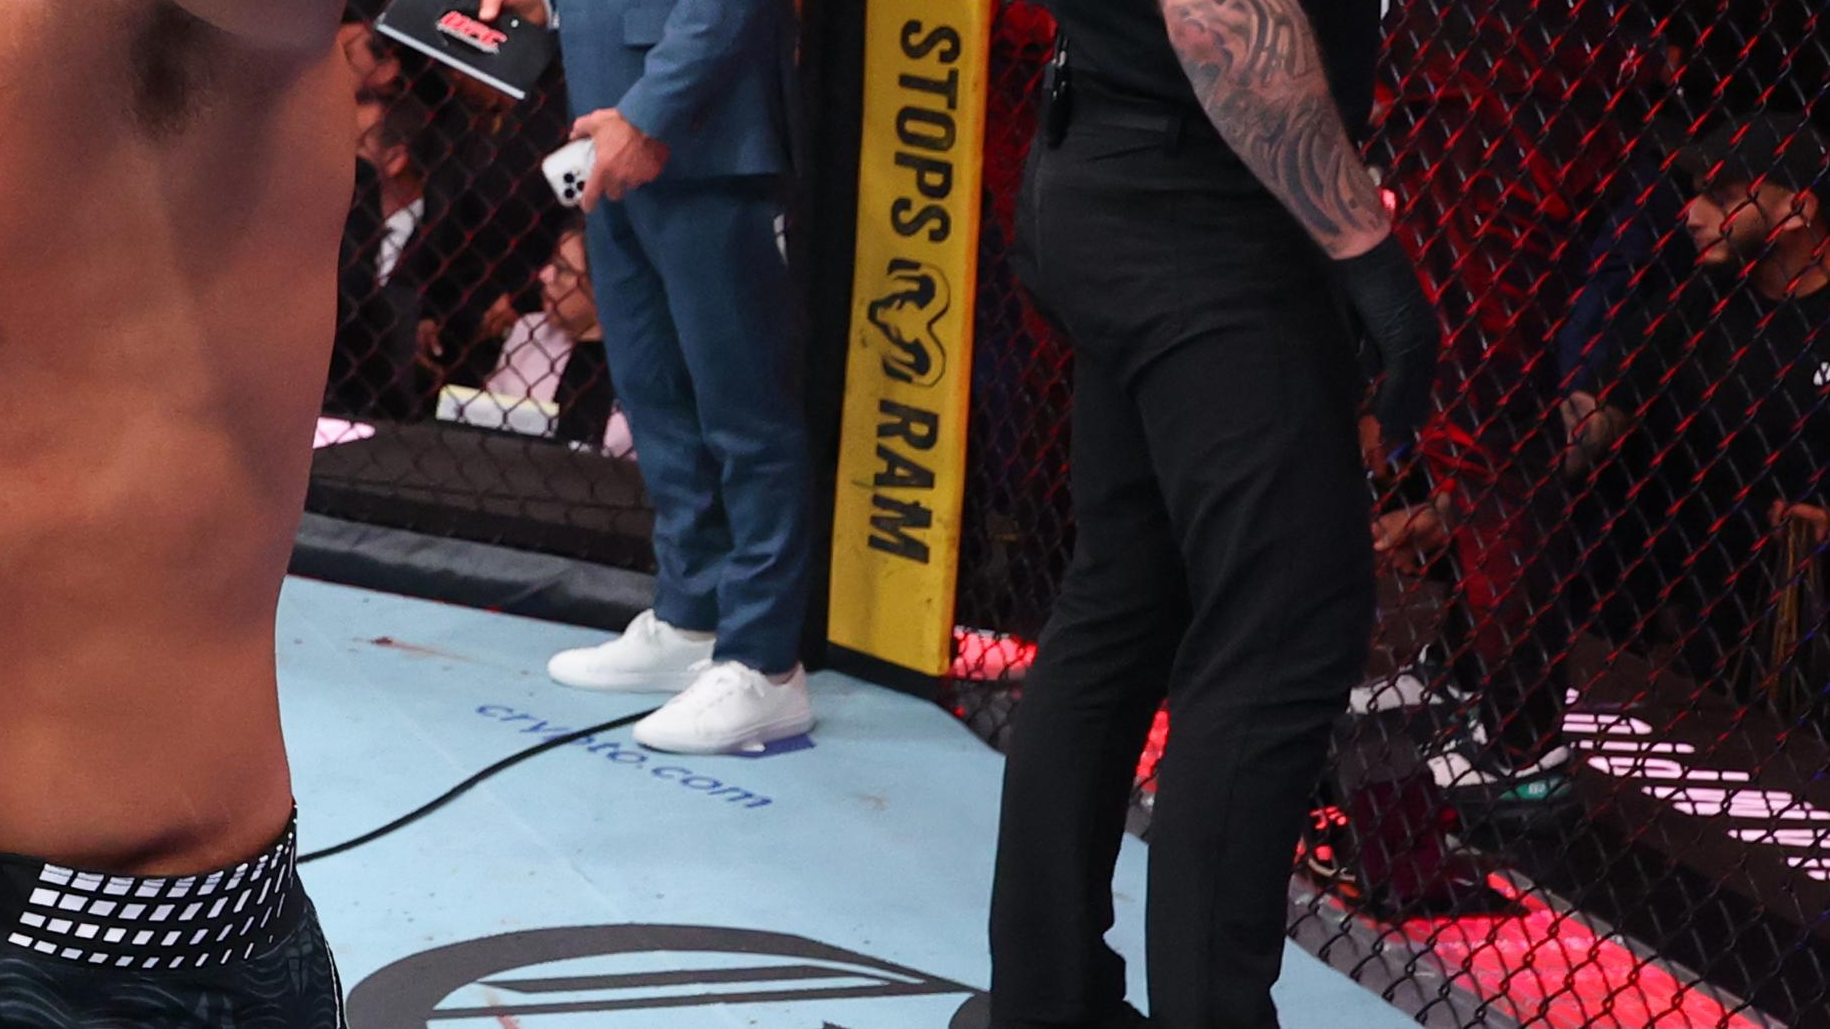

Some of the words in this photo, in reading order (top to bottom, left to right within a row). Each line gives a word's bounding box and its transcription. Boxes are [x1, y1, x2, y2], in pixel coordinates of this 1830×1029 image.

[891, 18, 961, 243] STOPS
[867, 399, 939, 565] RAM
[475, 703, 774, 809] crypto.com
